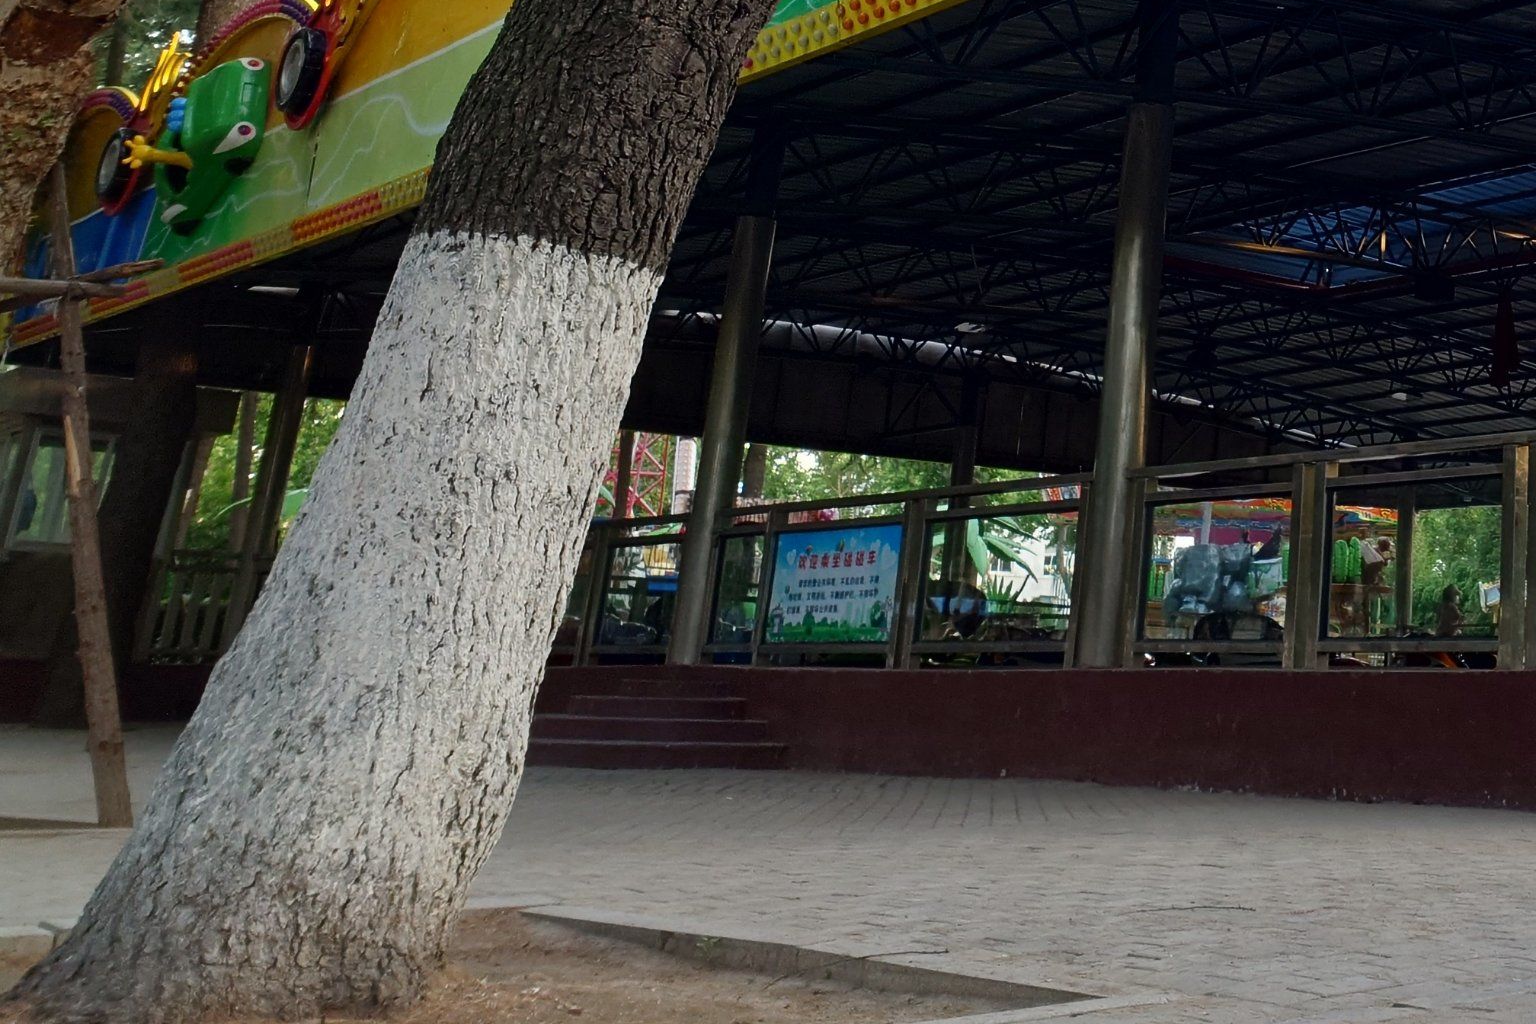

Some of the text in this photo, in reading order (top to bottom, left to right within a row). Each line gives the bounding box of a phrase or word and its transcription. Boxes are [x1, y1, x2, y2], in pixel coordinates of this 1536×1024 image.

[798, 551, 876, 569] 欢迎乘坐碰碰车
